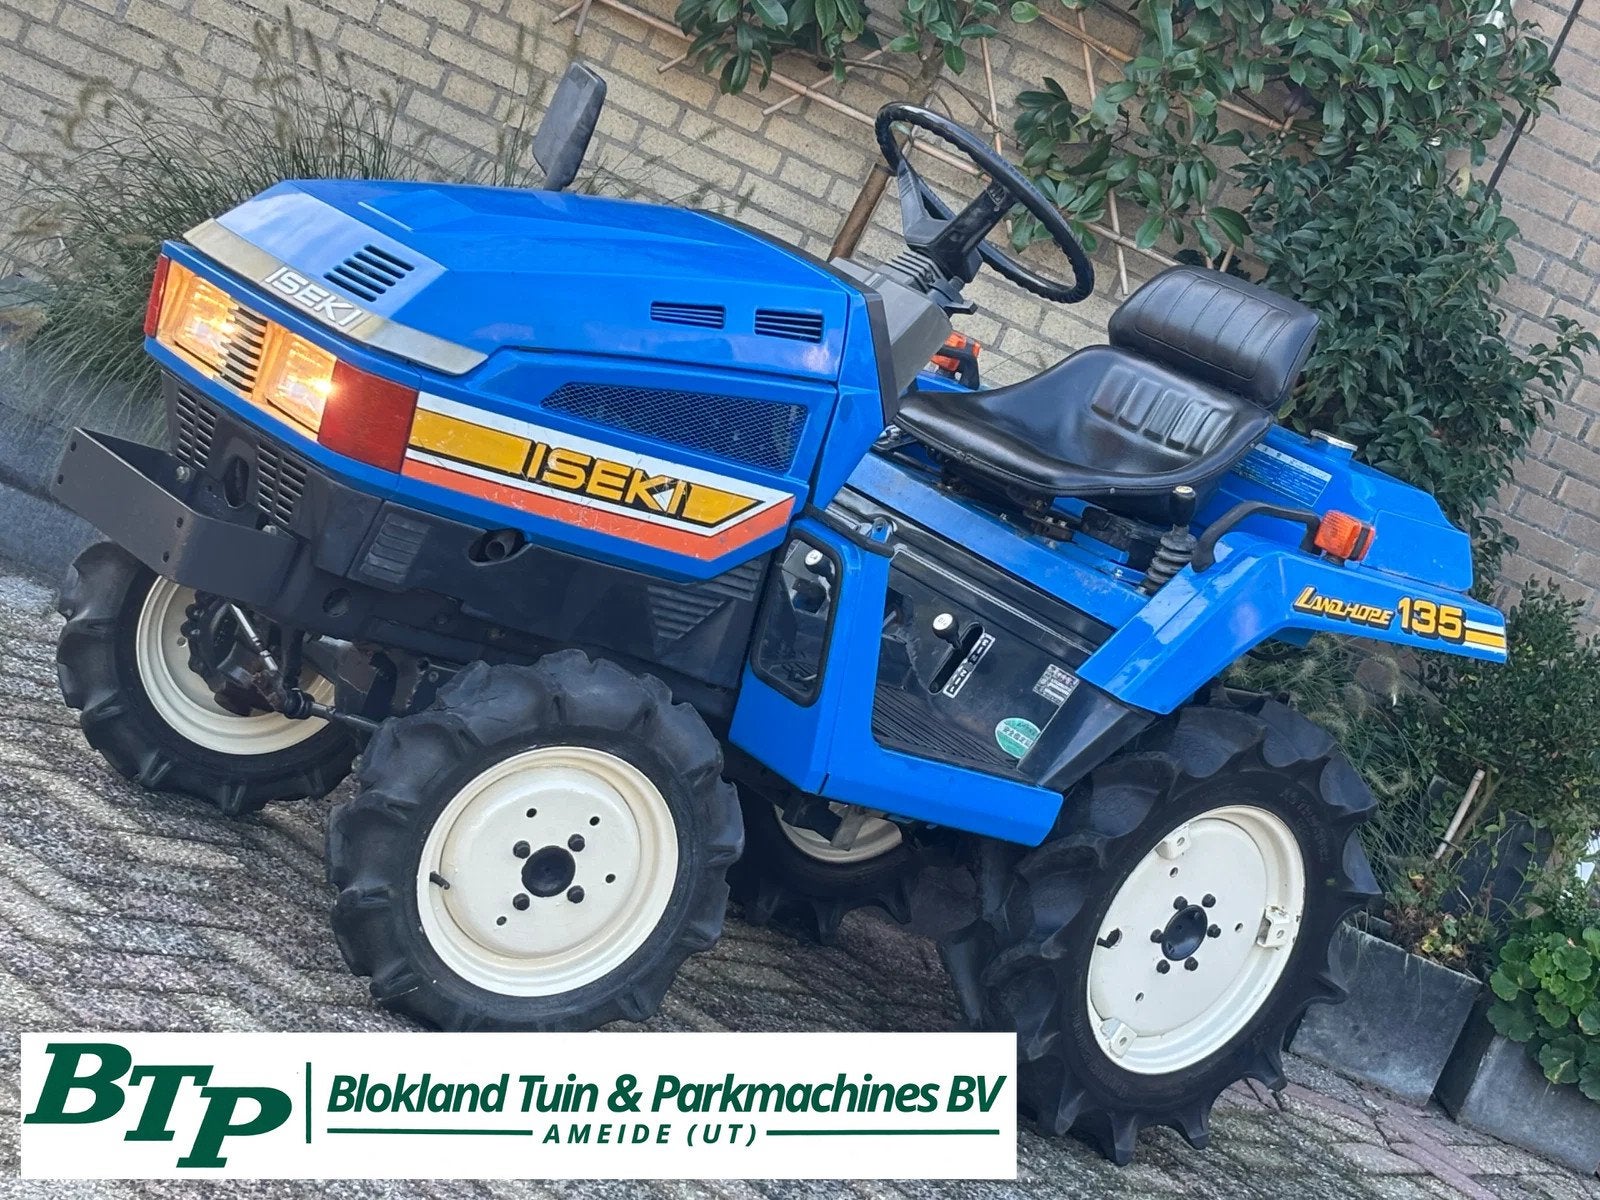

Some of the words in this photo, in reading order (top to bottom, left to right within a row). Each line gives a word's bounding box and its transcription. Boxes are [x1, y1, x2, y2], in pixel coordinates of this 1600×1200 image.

[265, 266, 363, 326] ISEKI
[526, 442, 688, 515] ISEKI
[1398, 596, 1465, 641] 135
